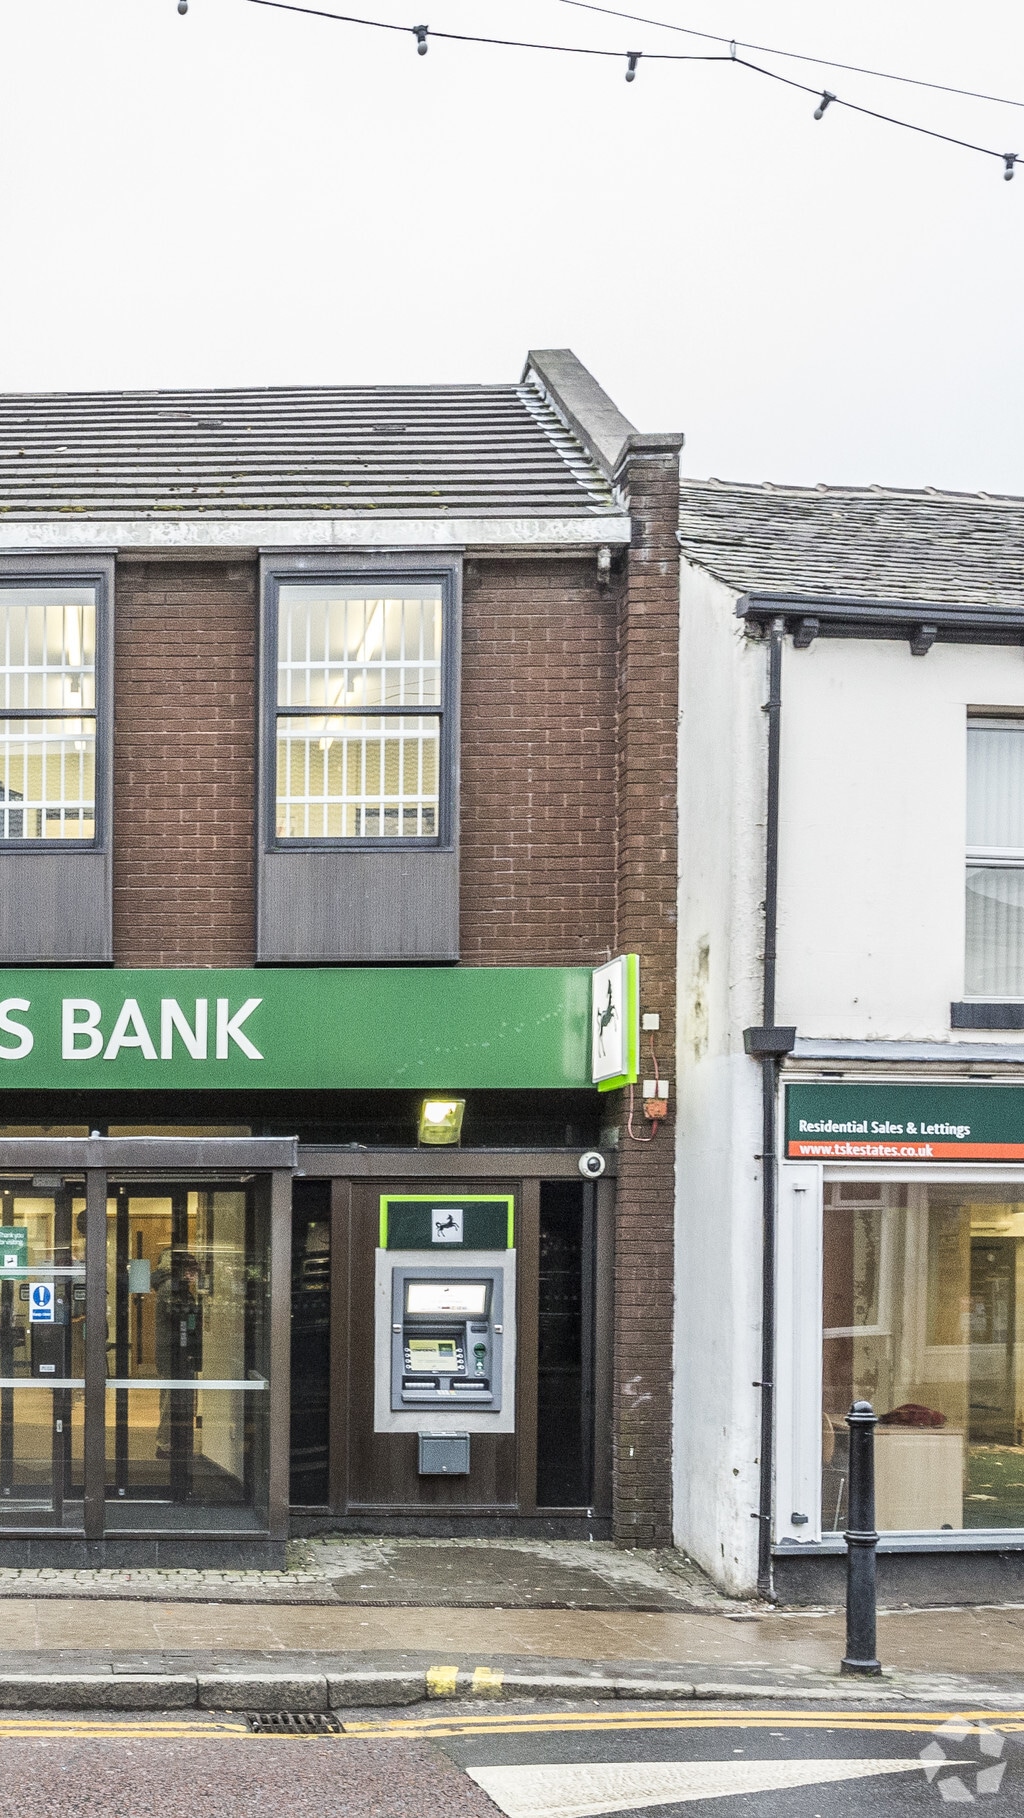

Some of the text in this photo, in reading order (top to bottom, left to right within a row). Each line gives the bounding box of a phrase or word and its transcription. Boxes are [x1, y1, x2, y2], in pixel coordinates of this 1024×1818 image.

[61, 998, 264, 1061] BANK
[799, 1119, 971, 1139] Residential Sales & Lettings
[799, 1142, 934, 1157] www.tskestates.co.uk
